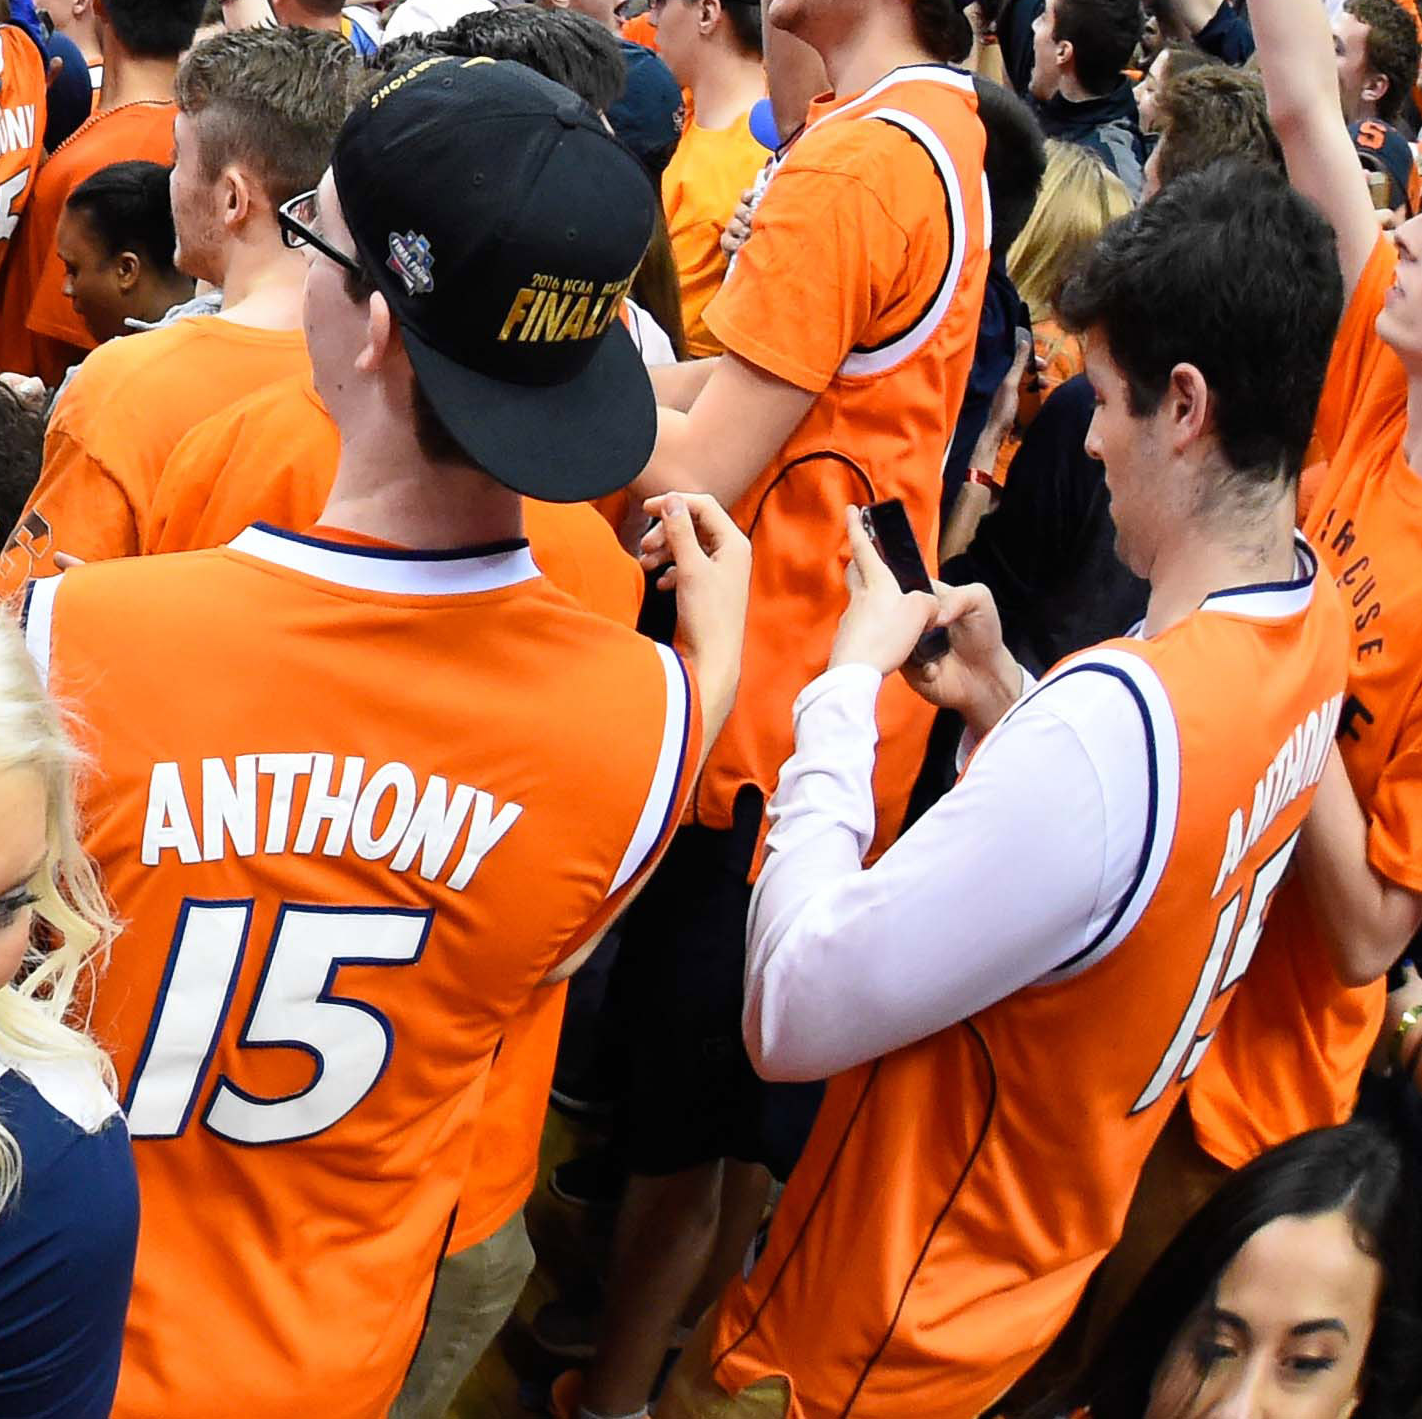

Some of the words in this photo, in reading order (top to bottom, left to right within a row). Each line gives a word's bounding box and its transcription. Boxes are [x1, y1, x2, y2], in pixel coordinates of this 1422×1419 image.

[1357, 121, 1386, 150] S
[531, 273, 560, 289] 2016
[562, 278, 594, 294] NCAA
[498, 288, 607, 342] FINAL
[140, 752, 524, 891] ANTHONY
[129, 898, 434, 1146] 15
